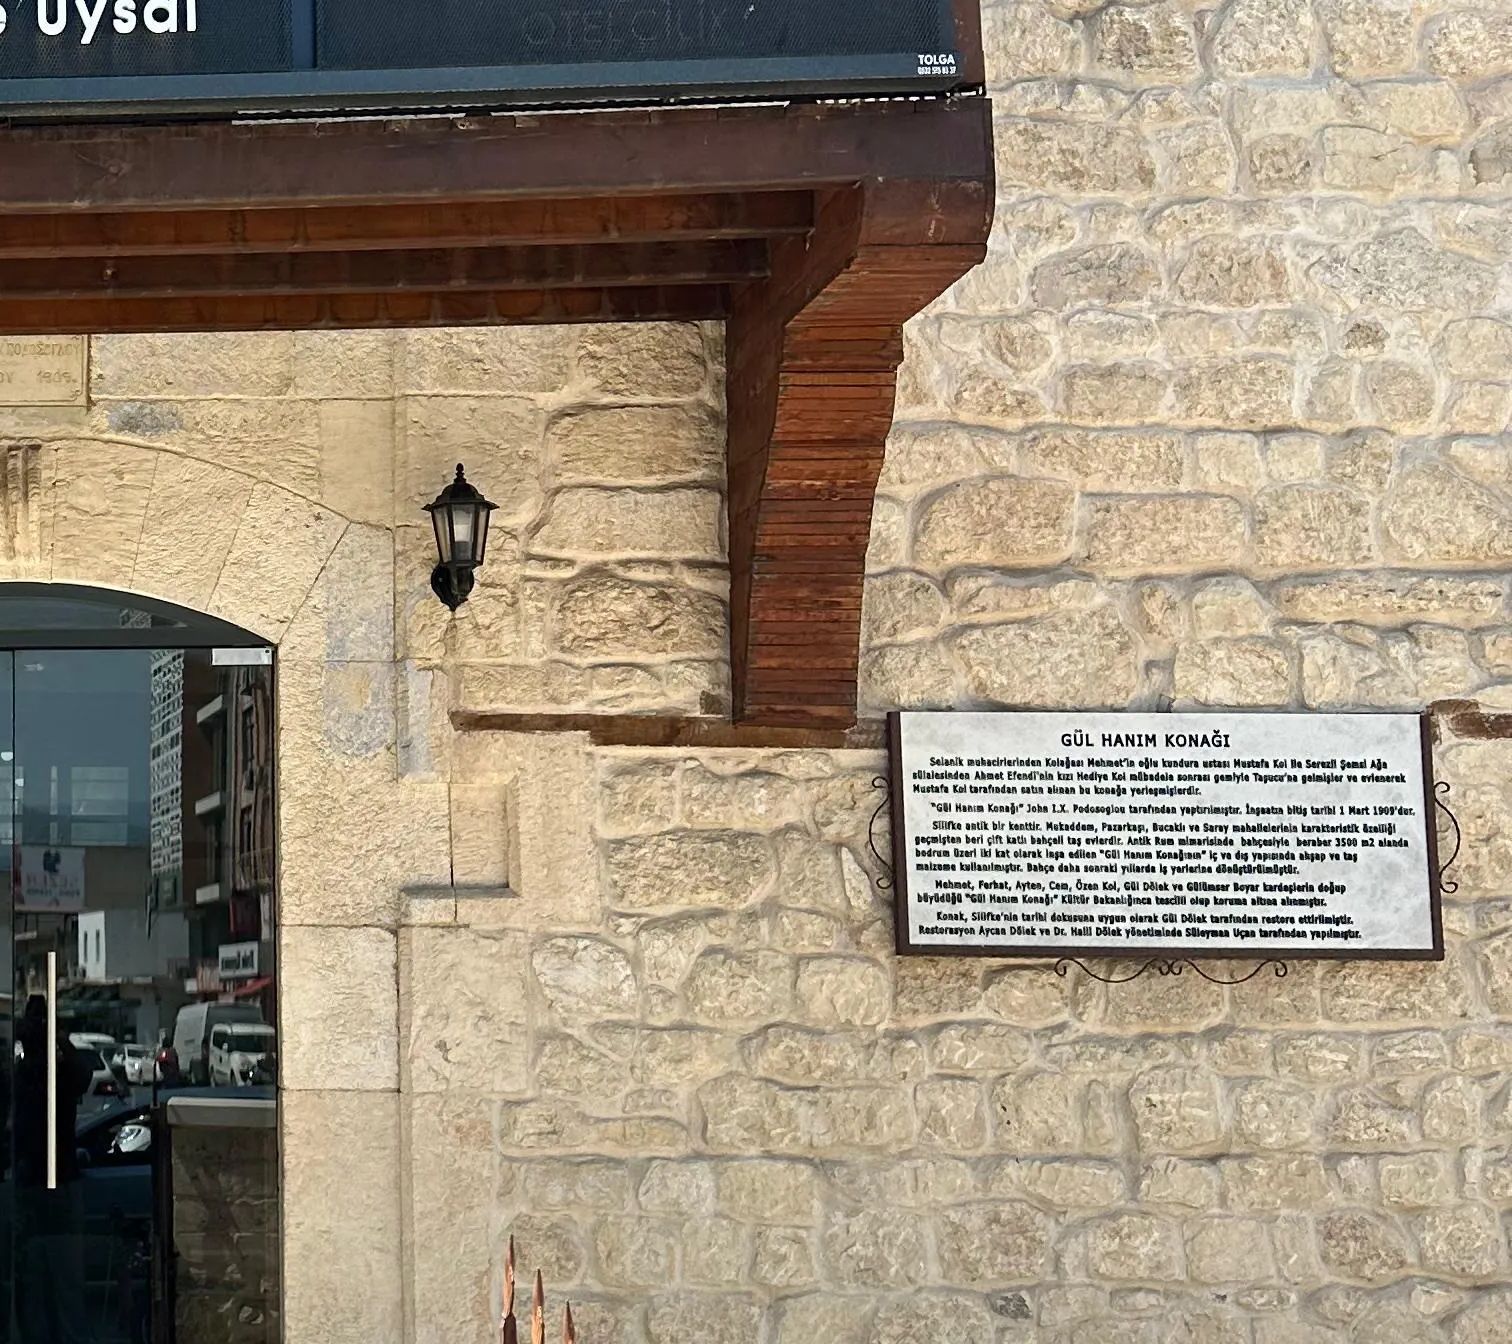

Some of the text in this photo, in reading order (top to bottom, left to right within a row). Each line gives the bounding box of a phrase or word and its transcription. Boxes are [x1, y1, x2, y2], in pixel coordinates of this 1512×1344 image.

[918, 54, 955, 65] TOLGA
[1061, 729, 1229, 747] GÜL HANIM KONAĞI
[1339, 806, 1344, 815] 1
